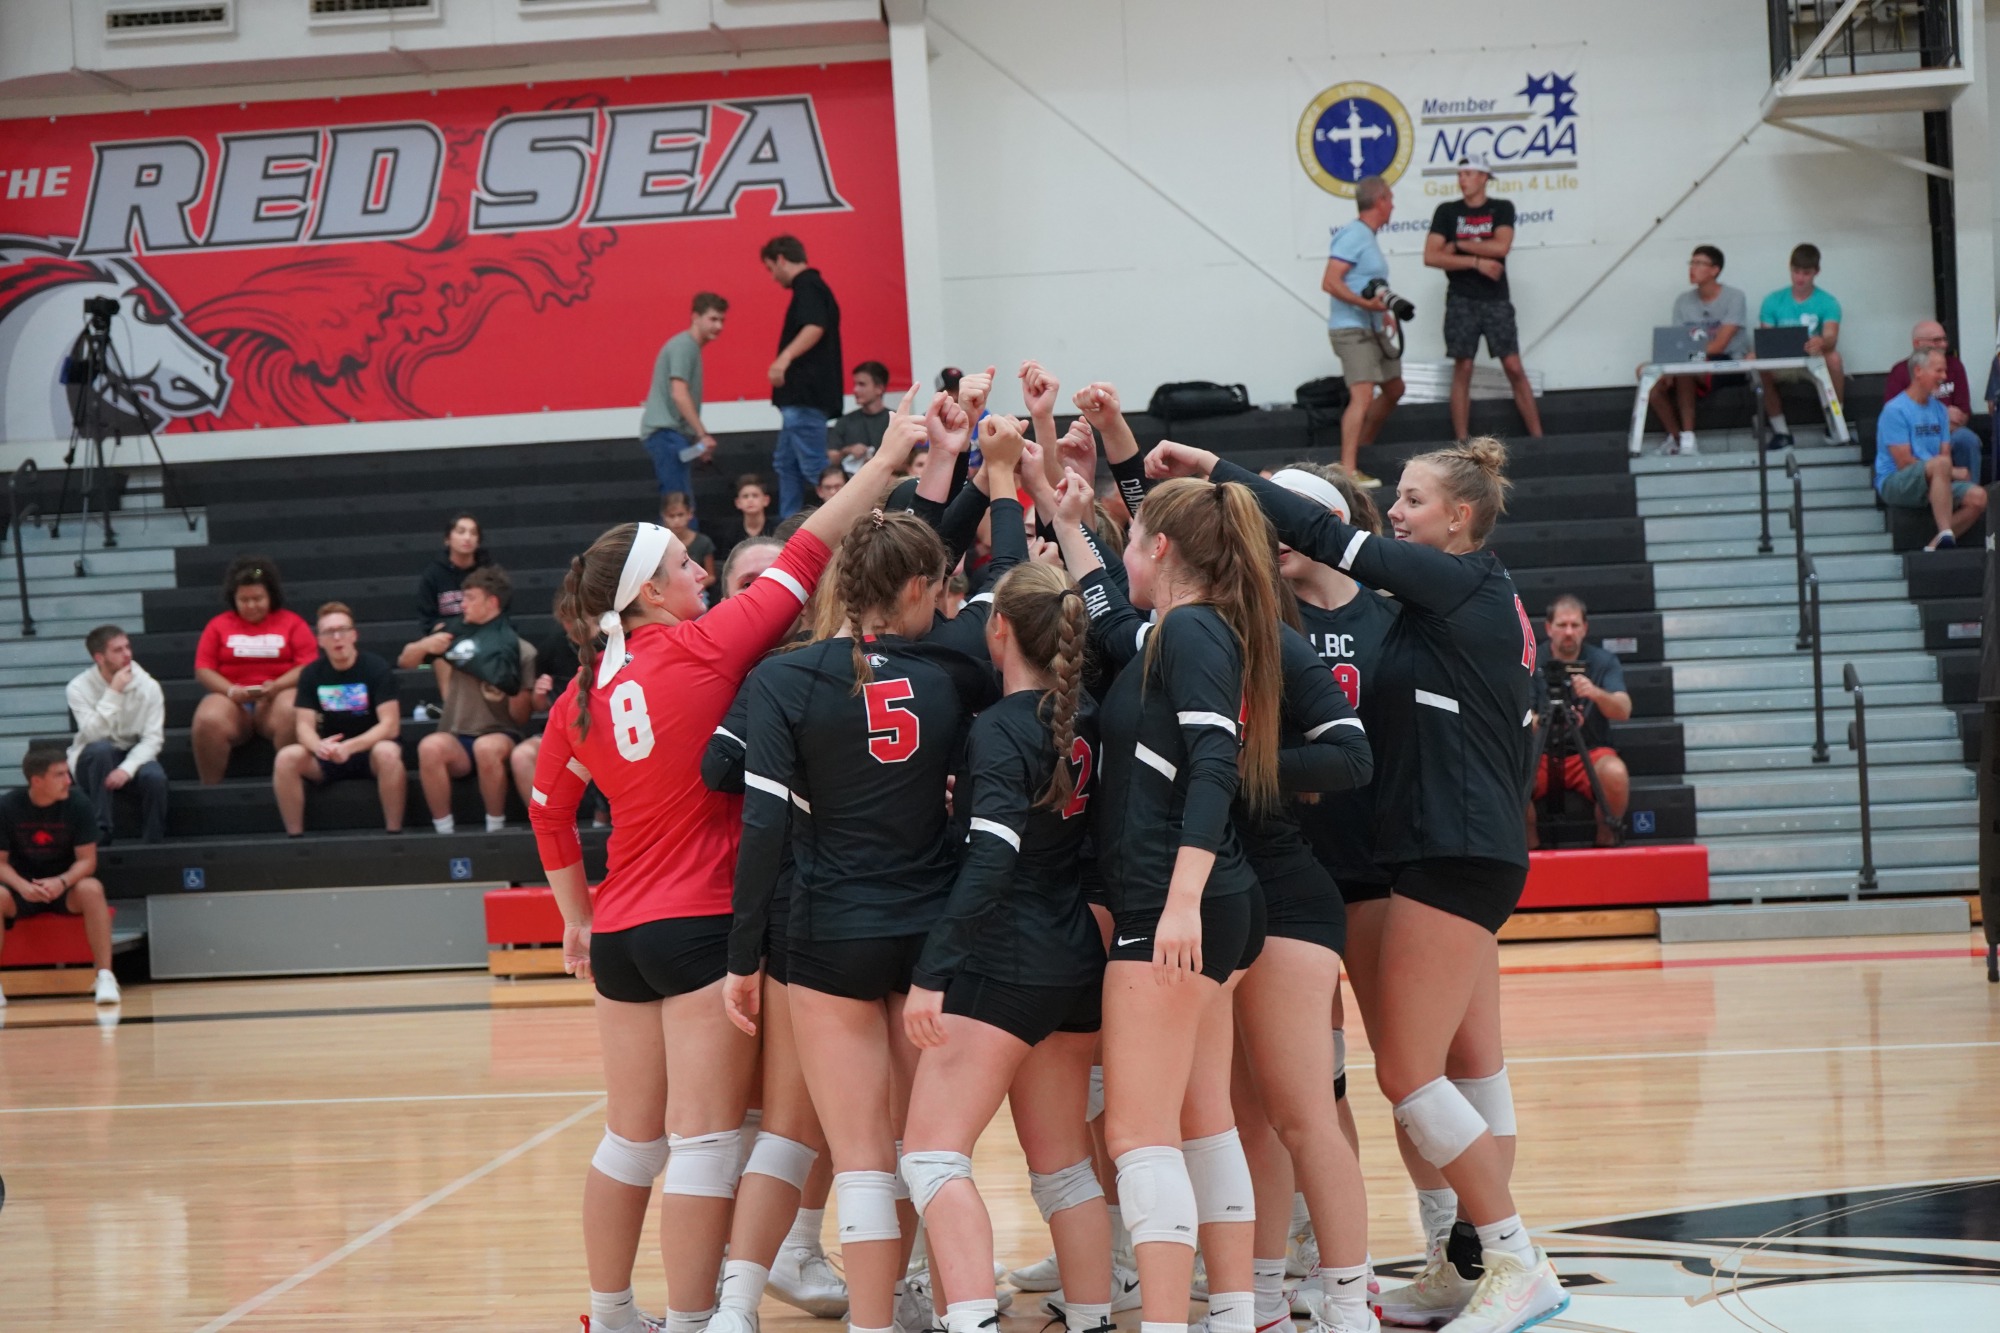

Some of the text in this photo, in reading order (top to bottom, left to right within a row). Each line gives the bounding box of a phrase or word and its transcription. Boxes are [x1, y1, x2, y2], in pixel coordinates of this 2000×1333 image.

[1422, 97, 1497, 115] Member
[1429, 122, 1577, 163] NCCAA
[0, 93, 853, 260] HE RED SEA
[1528, 175, 1539, 189] 4
[1544, 174, 1579, 191] Life
[609, 680, 656, 762] 8
[862, 678, 920, 764] 5
[1055, 735, 1093, 820] 2
